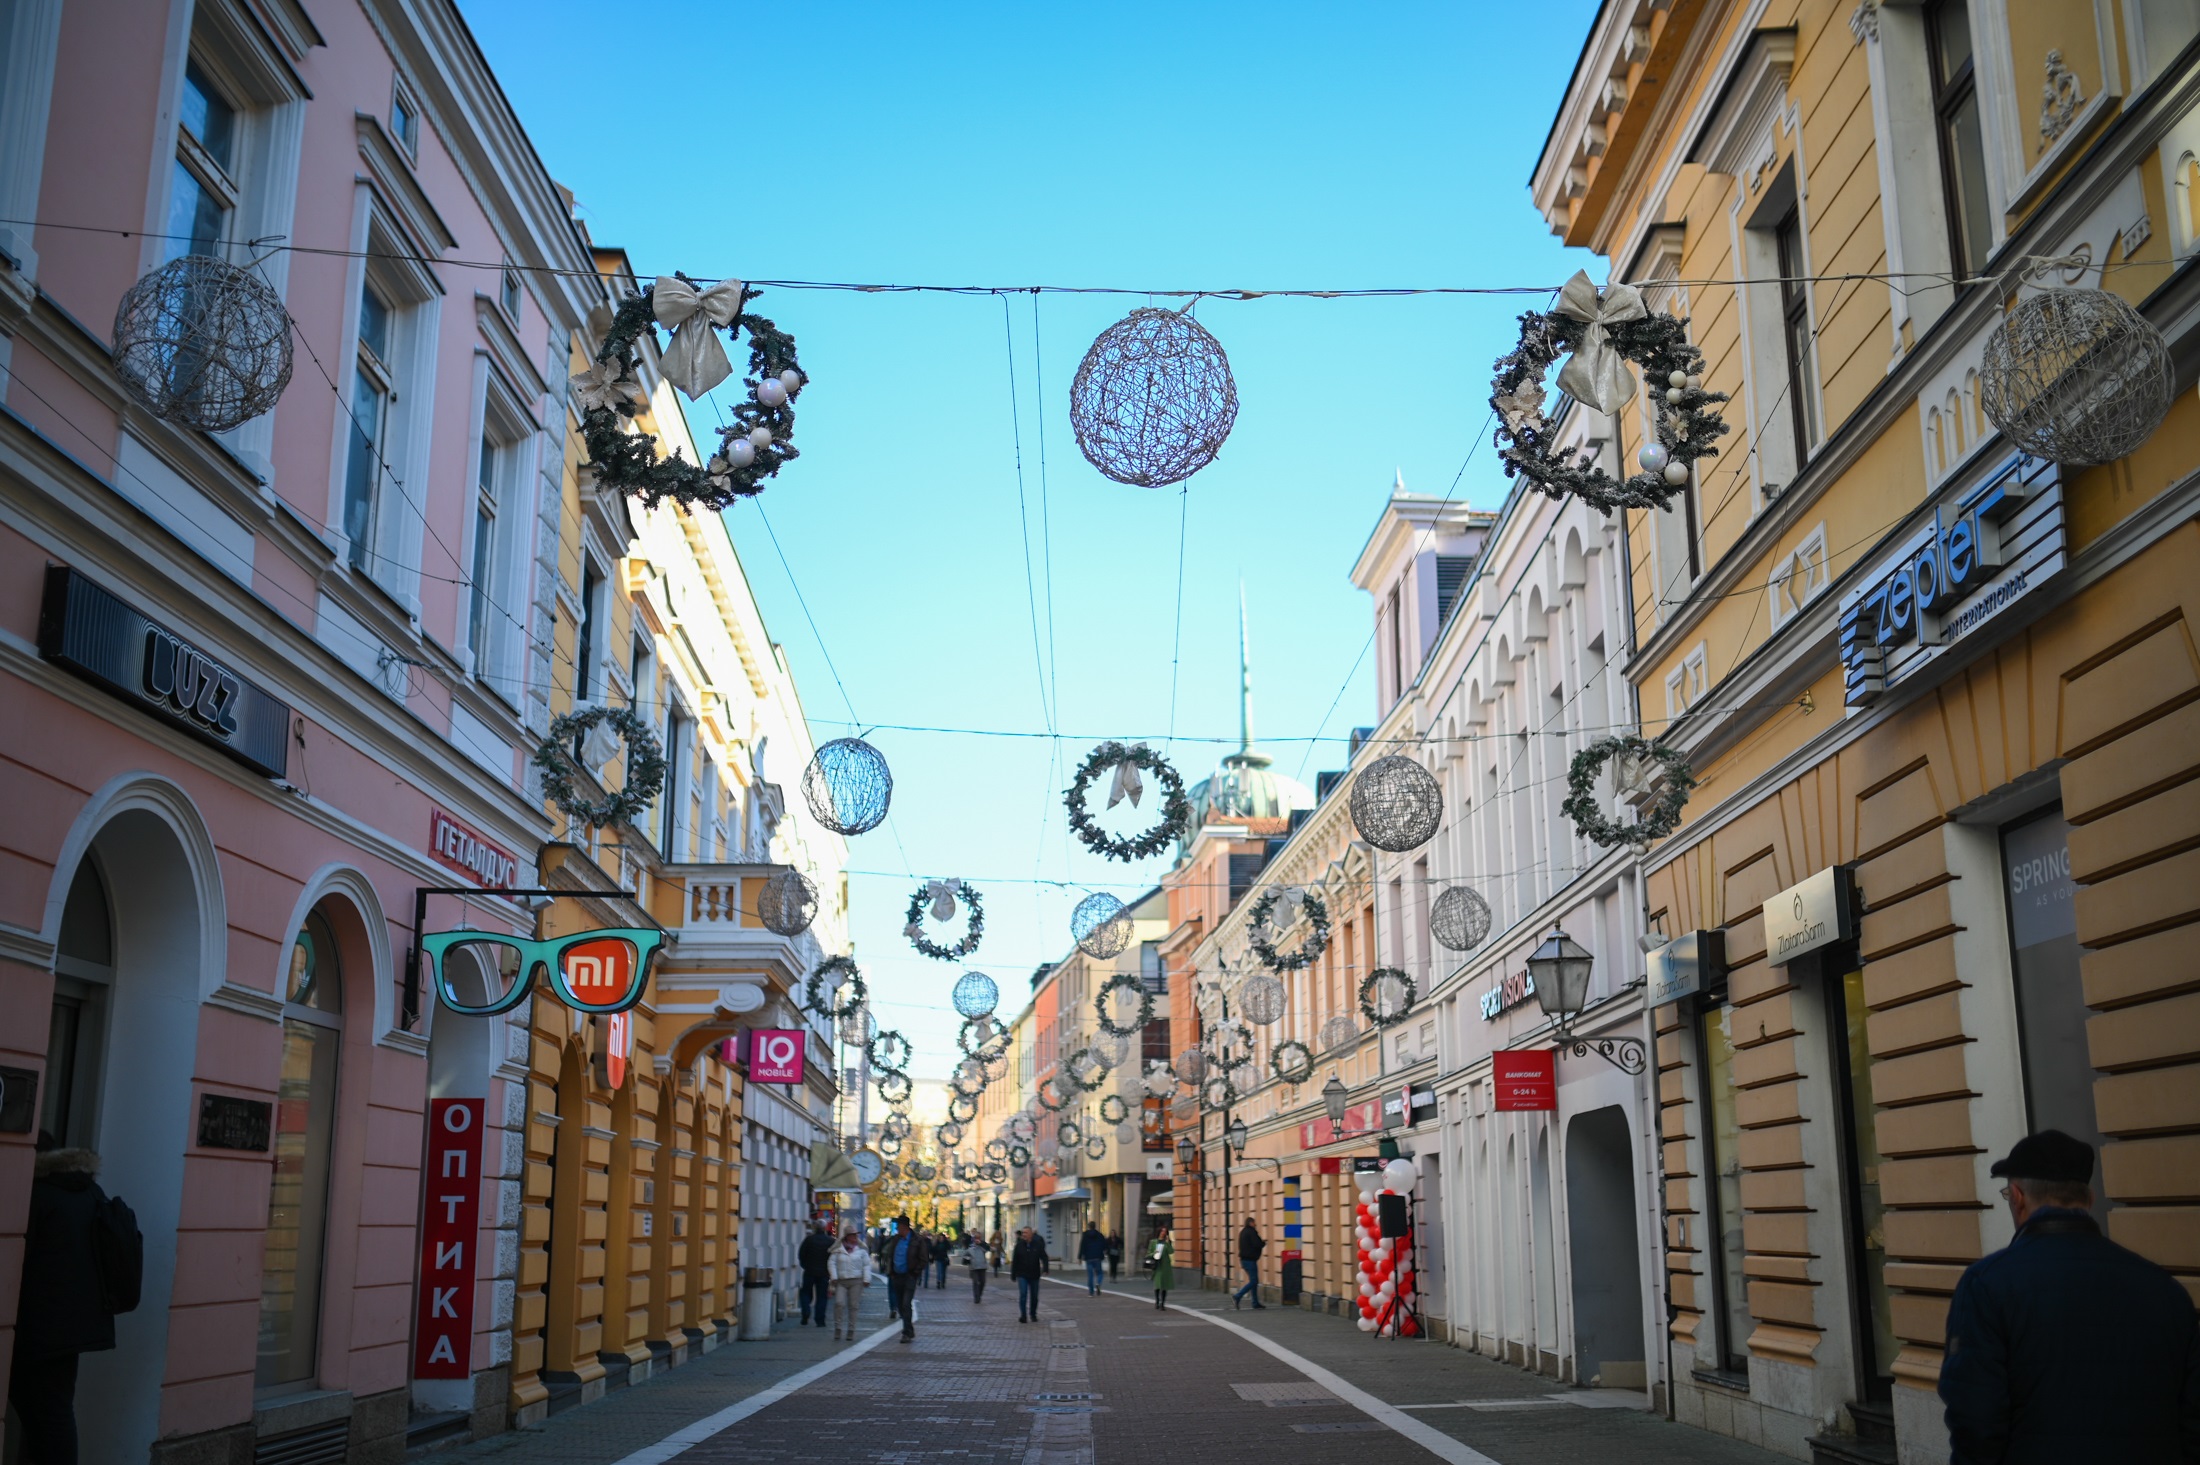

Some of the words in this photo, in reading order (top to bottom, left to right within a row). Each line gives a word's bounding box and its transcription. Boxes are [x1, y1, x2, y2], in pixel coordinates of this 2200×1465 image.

[1865, 484, 2008, 646] zepter
[1947, 571, 2028, 643] INTERNATIONAL
[148, 631, 240, 735] BUZZ
[435, 819, 515, 890] ГЕТАЛДУС
[2012, 846, 2071, 894] SPRING
[2036, 893, 2048, 908] AS
[2052, 885, 2073, 901] YOU
[757, 1068, 794, 1078] MOBILE
[758, 1035, 796, 1068] IQ
[1505, 1071, 1543, 1079] BANKOMAT
[428, 1103, 472, 1364] ОПТИКА
